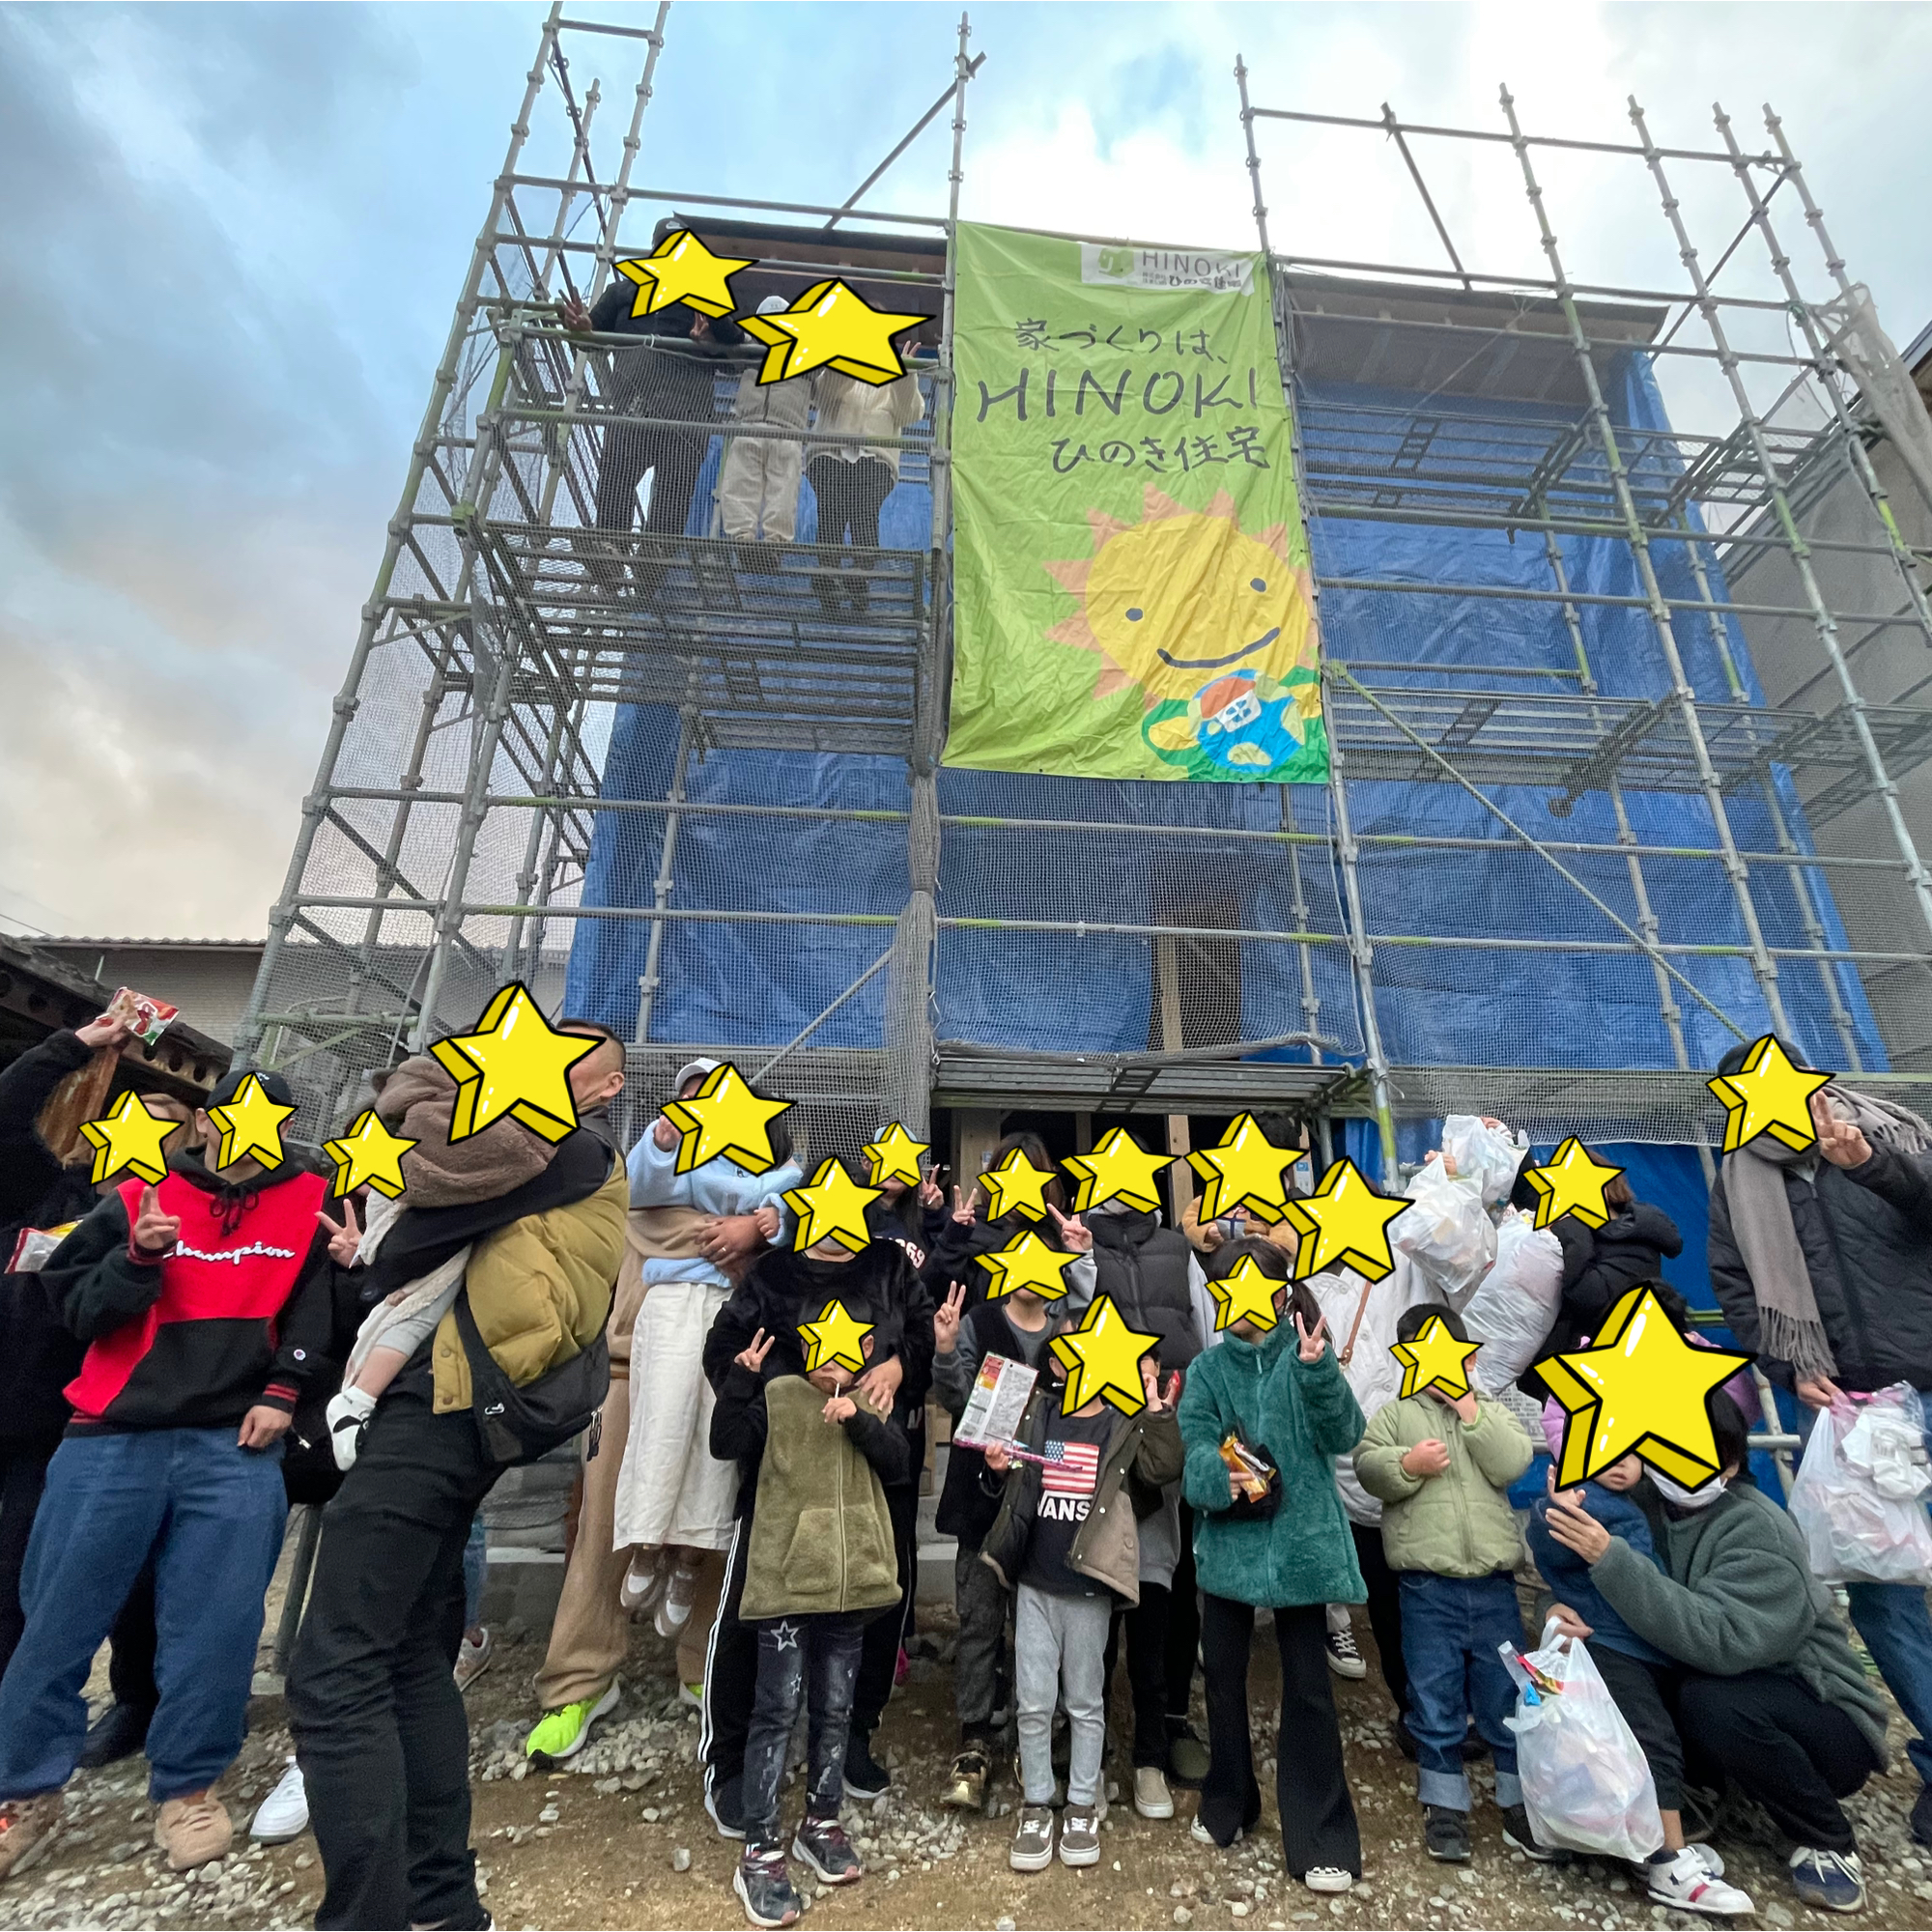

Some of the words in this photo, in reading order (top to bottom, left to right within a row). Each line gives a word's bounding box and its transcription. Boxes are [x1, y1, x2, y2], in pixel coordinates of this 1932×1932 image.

[1143, 251, 1239, 277] HINOKI
[1015, 317, 1228, 365] 家づくりは、
[976, 366, 1258, 423] HINOKI
[1050, 425, 1270, 474] ひのき住宅
[162, 1239, 296, 1265] hampion
